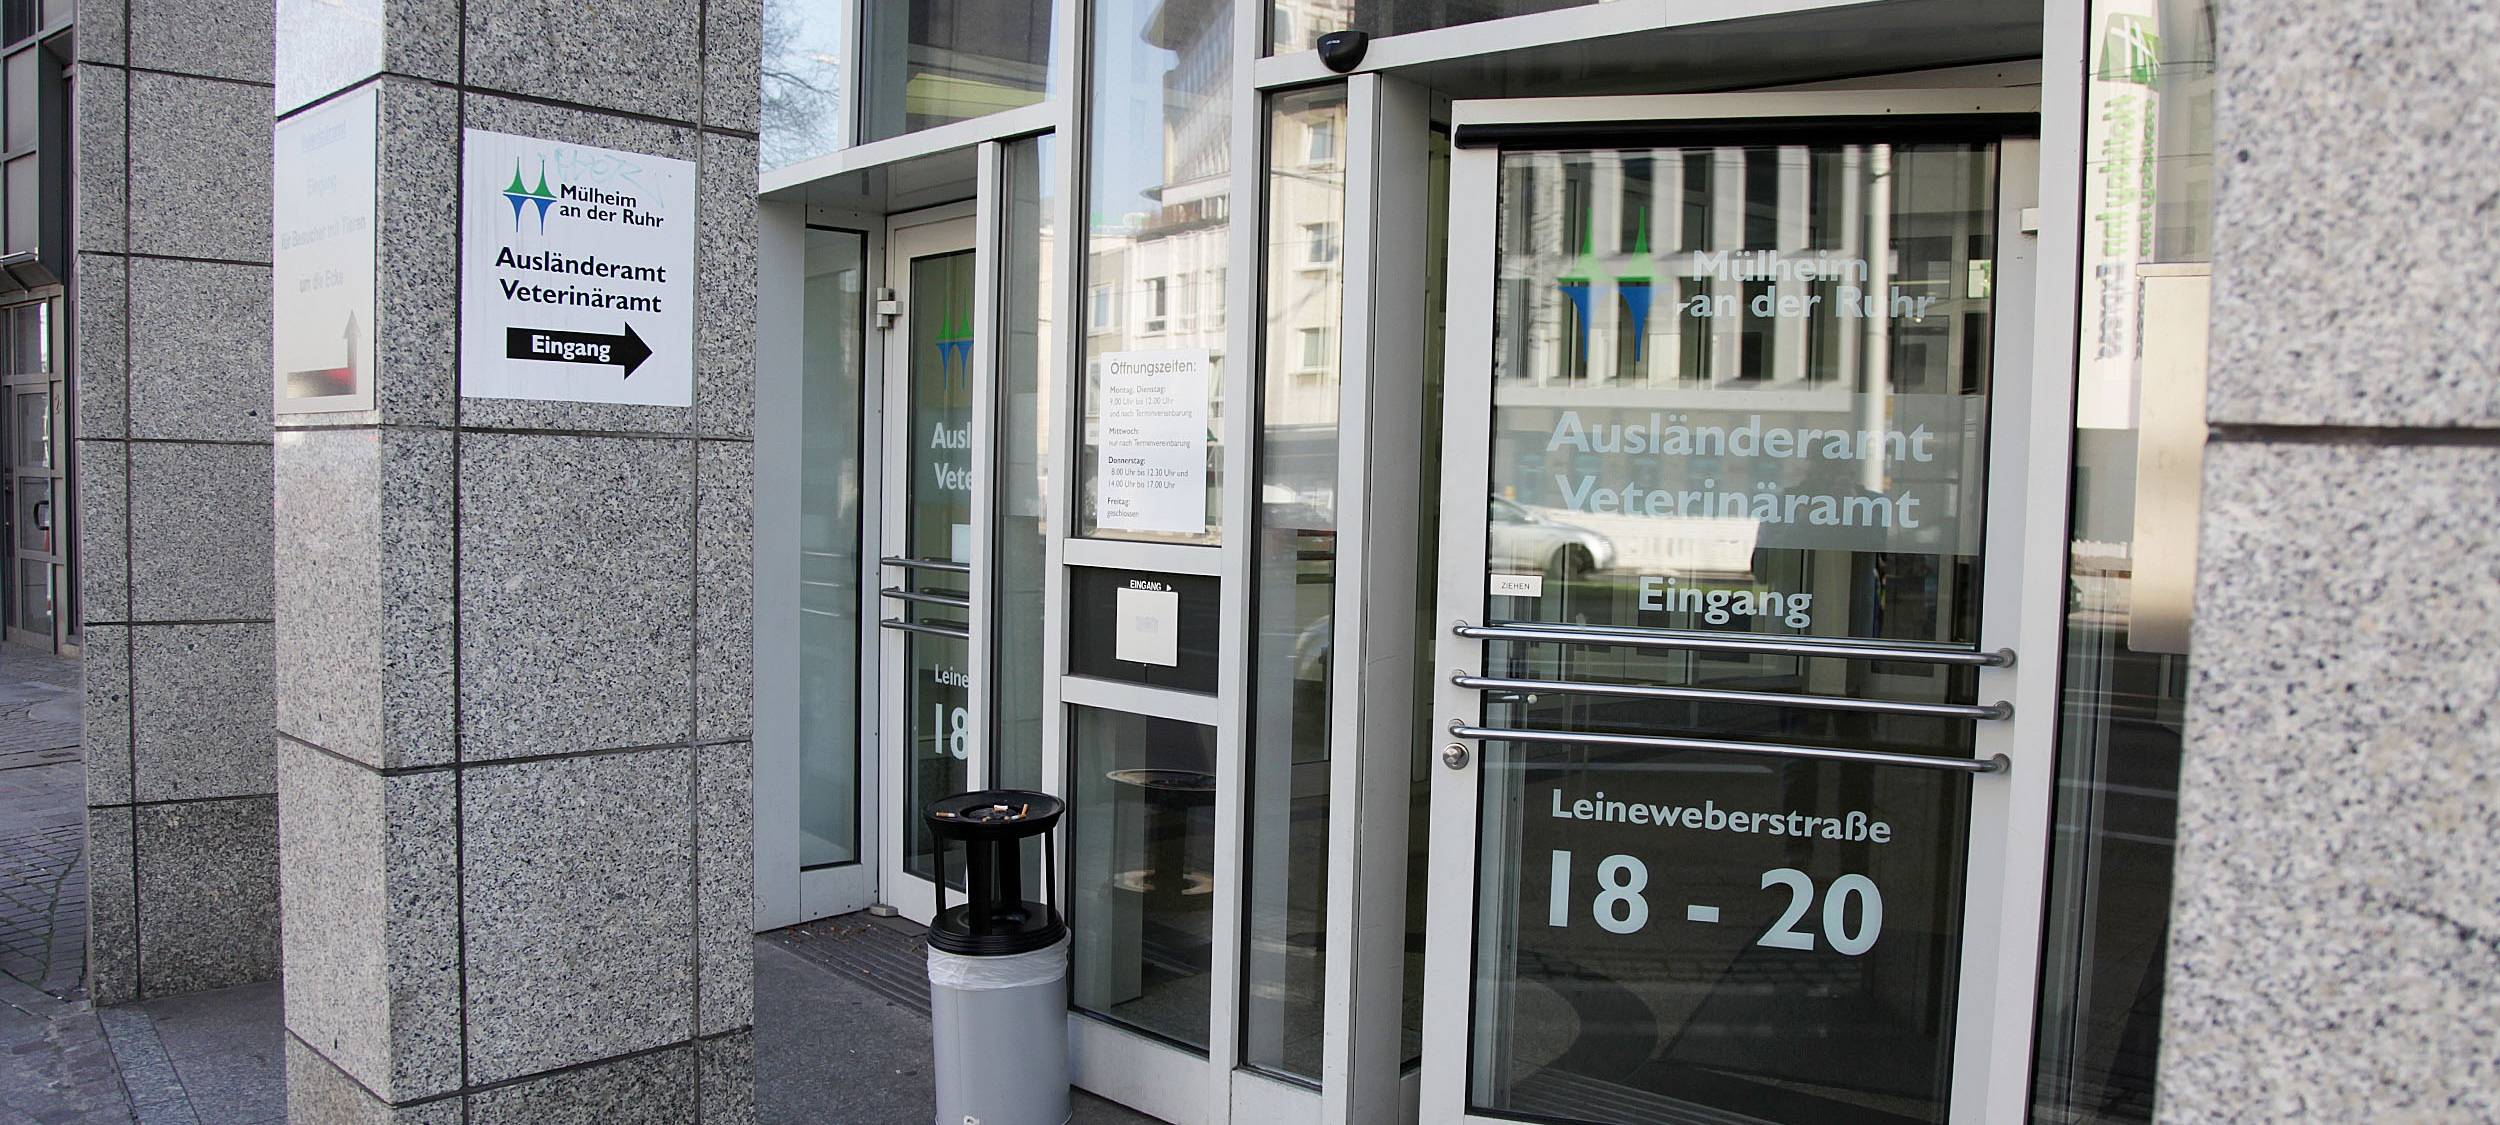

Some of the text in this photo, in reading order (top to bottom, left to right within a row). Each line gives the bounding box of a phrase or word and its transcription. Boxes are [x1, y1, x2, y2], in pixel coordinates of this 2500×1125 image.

[560, 183, 637, 208] Mülheim
[559, 204, 664, 228] an der Ruhr
[495, 246, 666, 283] Ausländeramt
[1692, 249, 1869, 283] Mülheim
[499, 278, 662, 313] Veterinäramt
[1690, 286, 1937, 320] an der Ruhr
[531, 334, 611, 363] Eingang
[1110, 358, 1197, 377] Öffnungszeiten:
[1546, 410, 1934, 463] Ausländeramt
[1108, 456, 1146, 466] Donnerstag:
[1124, 467, 1136, 477] Uhr
[1137, 468, 1146, 477] bis
[1163, 469, 1176, 478] Uhr
[1555, 474, 1921, 529] Veterinäramt
[1129, 579, 1162, 591] EINGANG
[1501, 581, 1530, 590] ZIEHEN
[1638, 575, 1814, 629] Eingang
[935, 703, 969, 761] 18
[1551, 788, 1892, 844] Leineweberstraße
[1548, 849, 1649, 935] 18
[1756, 867, 1884, 957] 20
